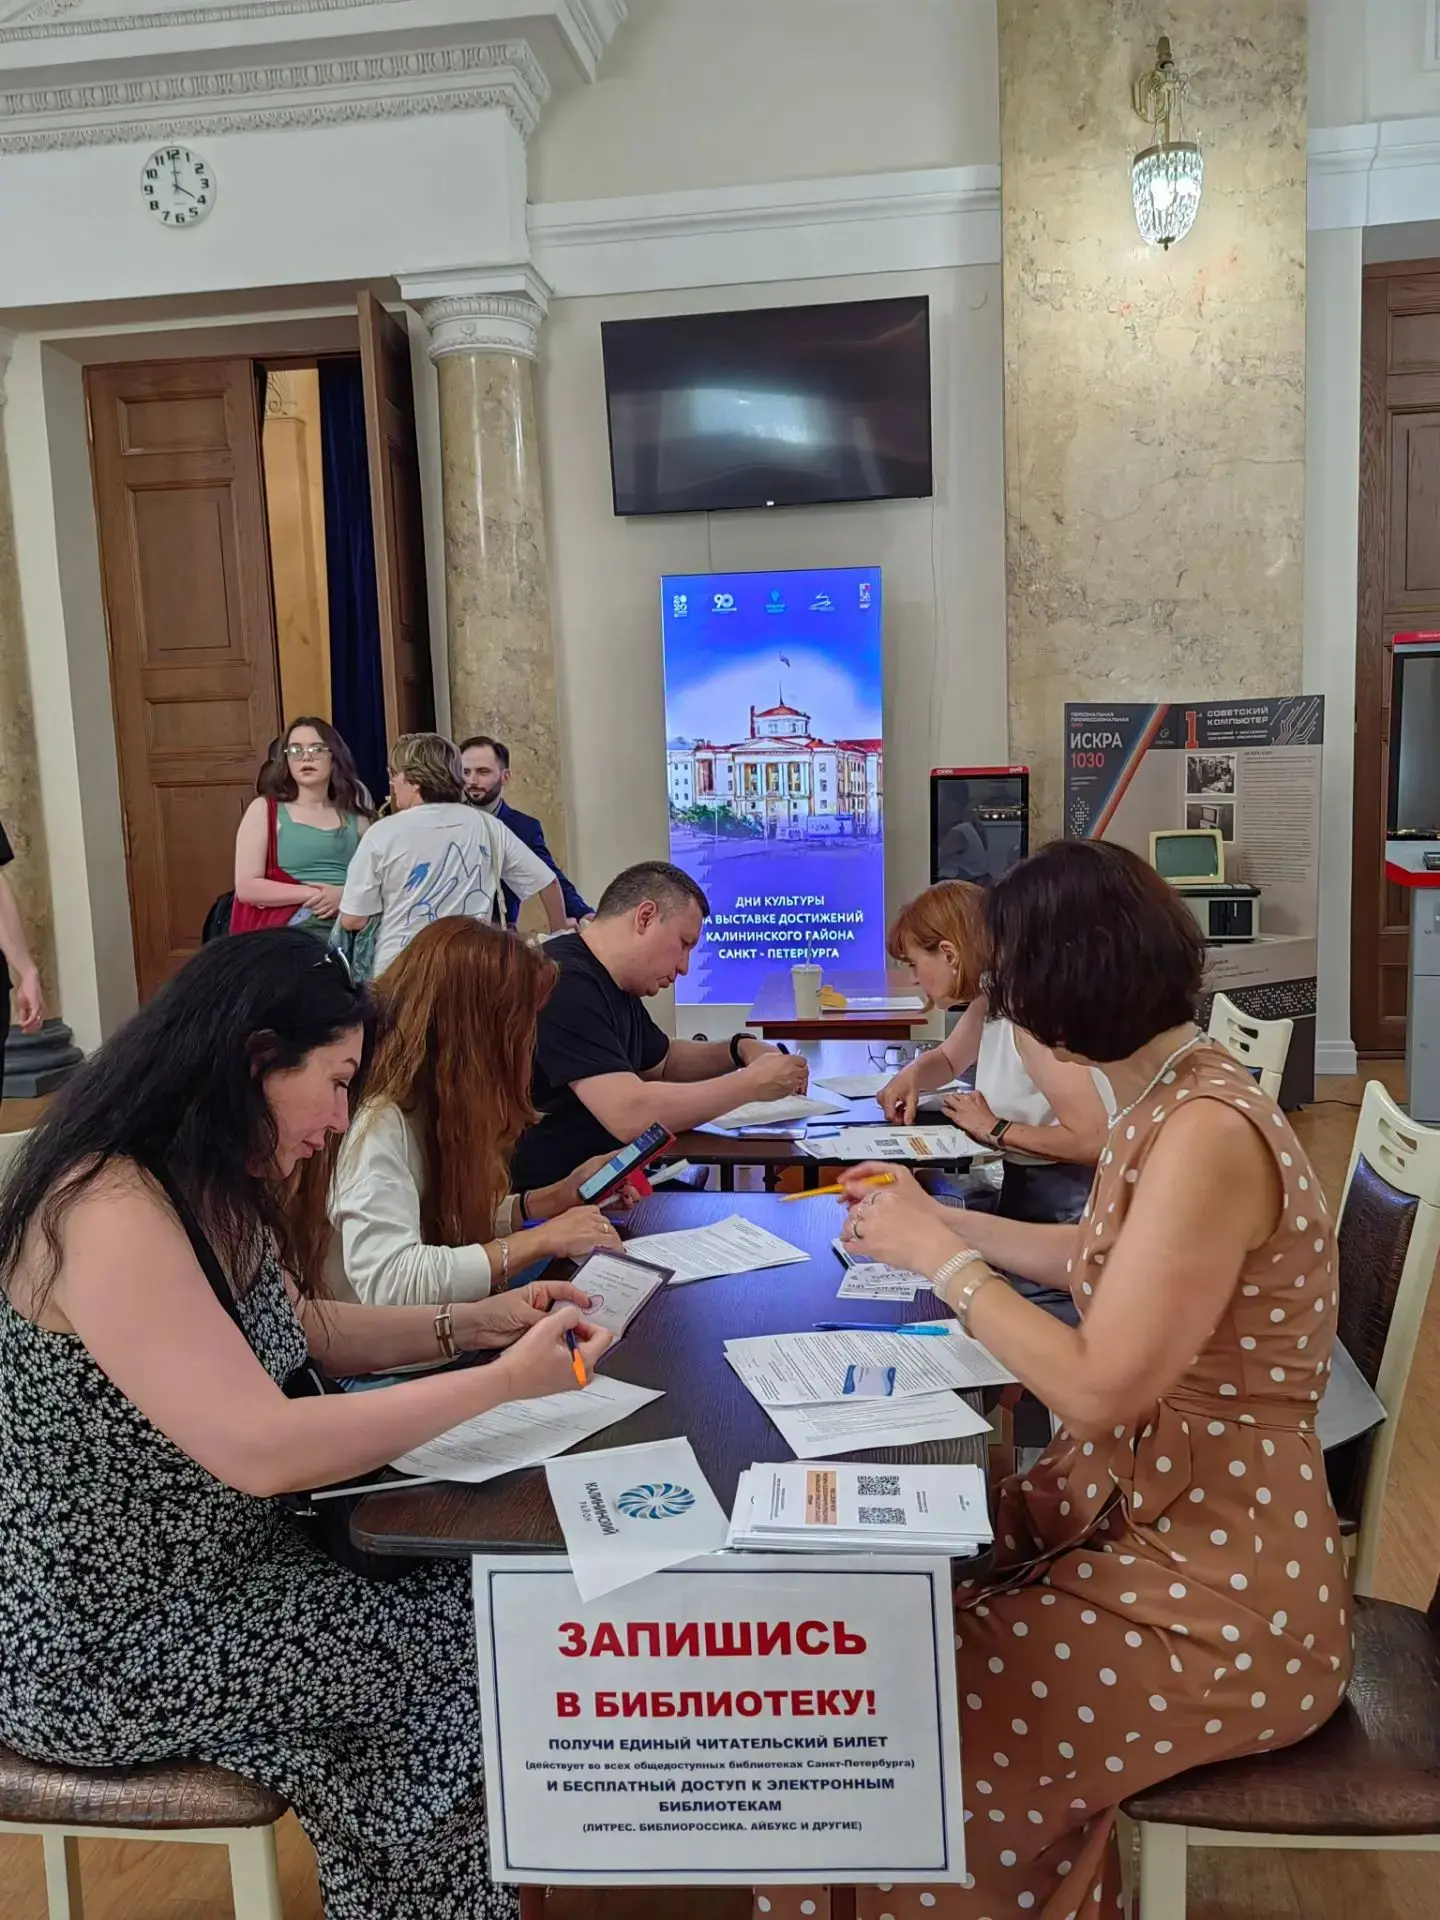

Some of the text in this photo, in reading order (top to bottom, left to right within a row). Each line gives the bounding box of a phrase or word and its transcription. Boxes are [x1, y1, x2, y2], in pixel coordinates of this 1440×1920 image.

[155, 155, 164, 166] 11
[166, 149, 180, 161] 12
[185, 152, 190, 162] 1
[146, 168, 158, 179] 10
[194, 163, 204, 174] 2
[200, 178, 209, 188] 3
[143, 184, 154, 195] 9
[197, 194, 206, 204] 4
[149, 200, 159, 210] 8
[161, 210, 170, 221] 7
[188, 206, 198, 217] 5
[175, 213, 185, 223] 6
[713, 594, 734, 608] 90
[1207, 706, 1269, 717] СОВЕТСКИЙ
[1207, 716, 1269, 726] КОМПЬЮТЕР
[1070, 732, 1123, 749] ИСКРА
[1071, 752, 1105, 768] 1030
[735, 895, 825, 909] ДНИ КУЛЬТУРЫ
[715, 914, 777, 925] ВЫСТАВКЕ
[778, 909, 864, 926] ДОСТИЖЕНИЙ
[706, 931, 802, 942] КАЛИНИНСКОГО
[718, 948, 758, 959] САНКТ
[584, 1481, 620, 1536] КАЛИНИНСКИЙ
[557, 1620, 868, 1658] ЗАПИШИСЬ
[555, 1689, 877, 1719] В БИБЛИОТЕКУ!
[548, 1734, 889, 1751] ПОЛУЧИ ЕДИНЫЙ ЧИТАТЕЛЬСКИЙ БИЛЕТ
[525, 1760, 585, 1772] (действует
[634, 1761, 726, 1771] общедоступных
[729, 1760, 803, 1770] библиотеках
[806, 1758, 915, 1770] Санкт-Петербурга)
[547, 1778, 895, 1793] И БЕСПЛАТНЫЙ ДОСТУП К ЭЛЕКТРОННЫМ
[659, 1800, 782, 1812] БИБЛИОТЕКАМ
[751, 1820, 797, 1831] АЙБУКС
[801, 1822, 809, 1831] И
[812, 1821, 863, 1832] ДРУГИЕ)
